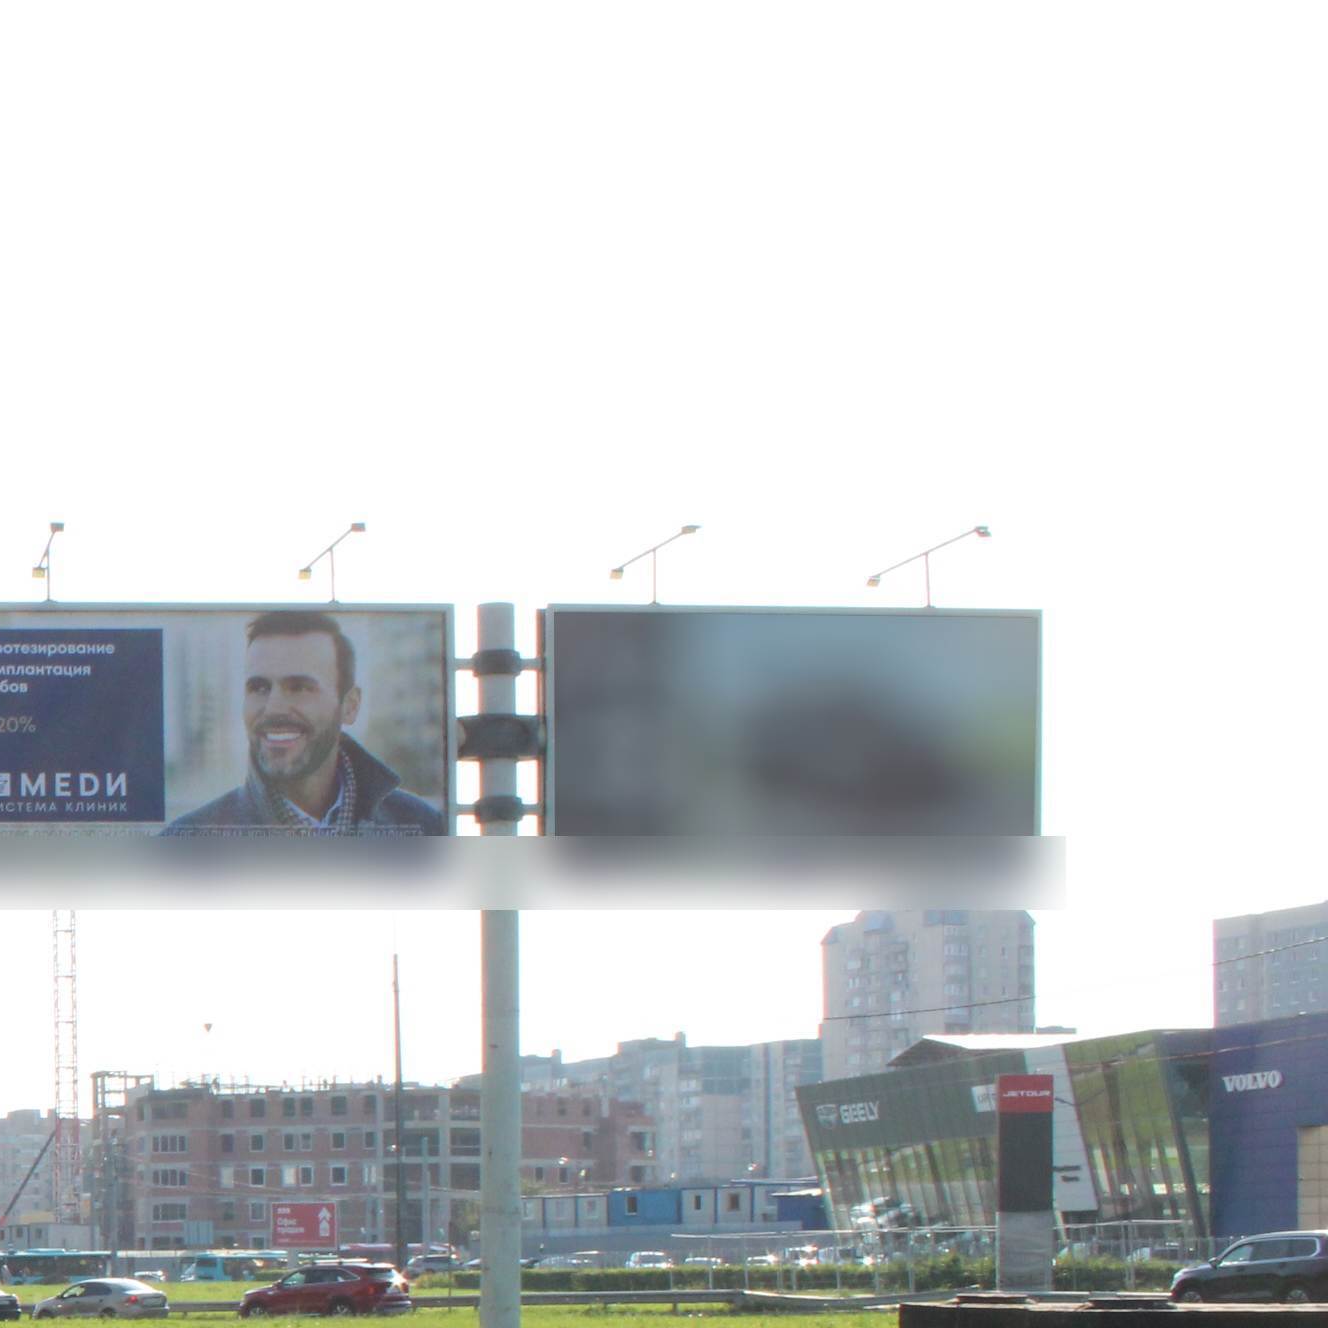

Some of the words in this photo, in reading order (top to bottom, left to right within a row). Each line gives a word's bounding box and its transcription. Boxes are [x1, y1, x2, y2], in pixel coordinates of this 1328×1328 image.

[65, 802, 127, 812] КЛИНИК
[1222, 1070, 1282, 1092] VOLVO
[840, 1101, 880, 1124] GEELY
